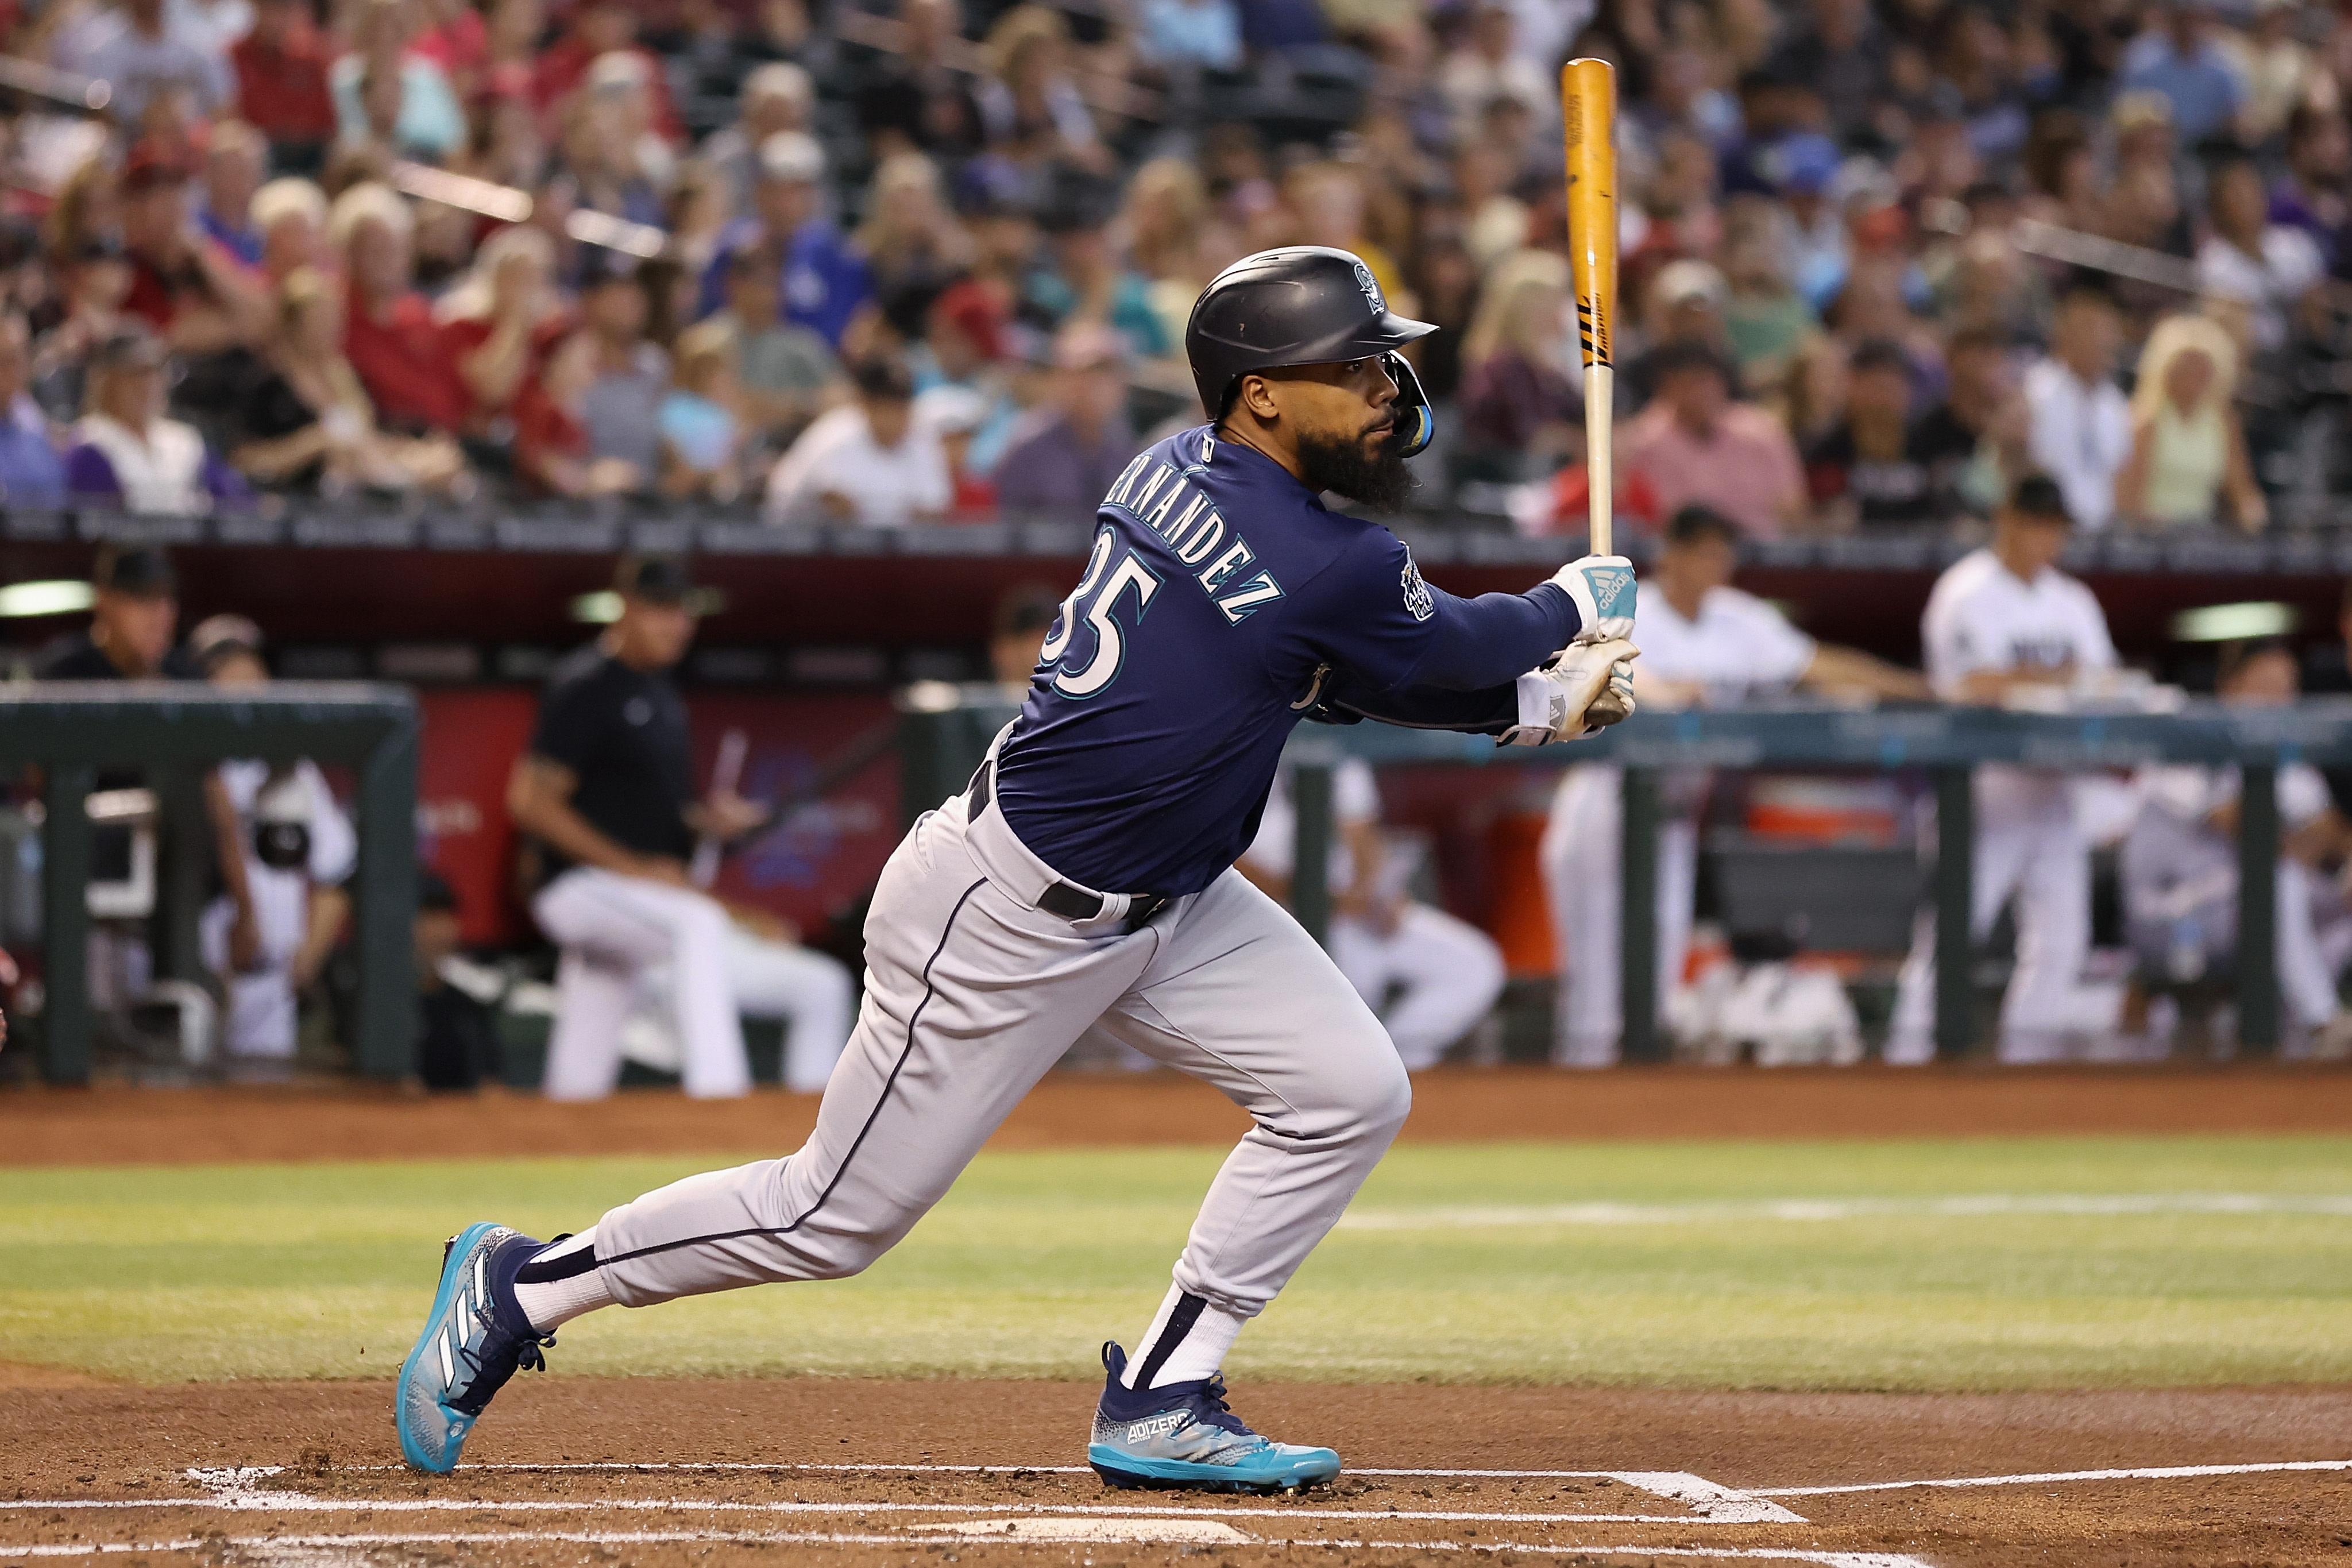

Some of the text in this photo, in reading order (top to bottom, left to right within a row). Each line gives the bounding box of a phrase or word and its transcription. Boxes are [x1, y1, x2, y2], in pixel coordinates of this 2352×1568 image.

[1099, 453, 1286, 627] ERNÁNDEZ
[1600, 572, 1630, 610] adidas
[1127, 1412, 1189, 1441] ADIZERO
